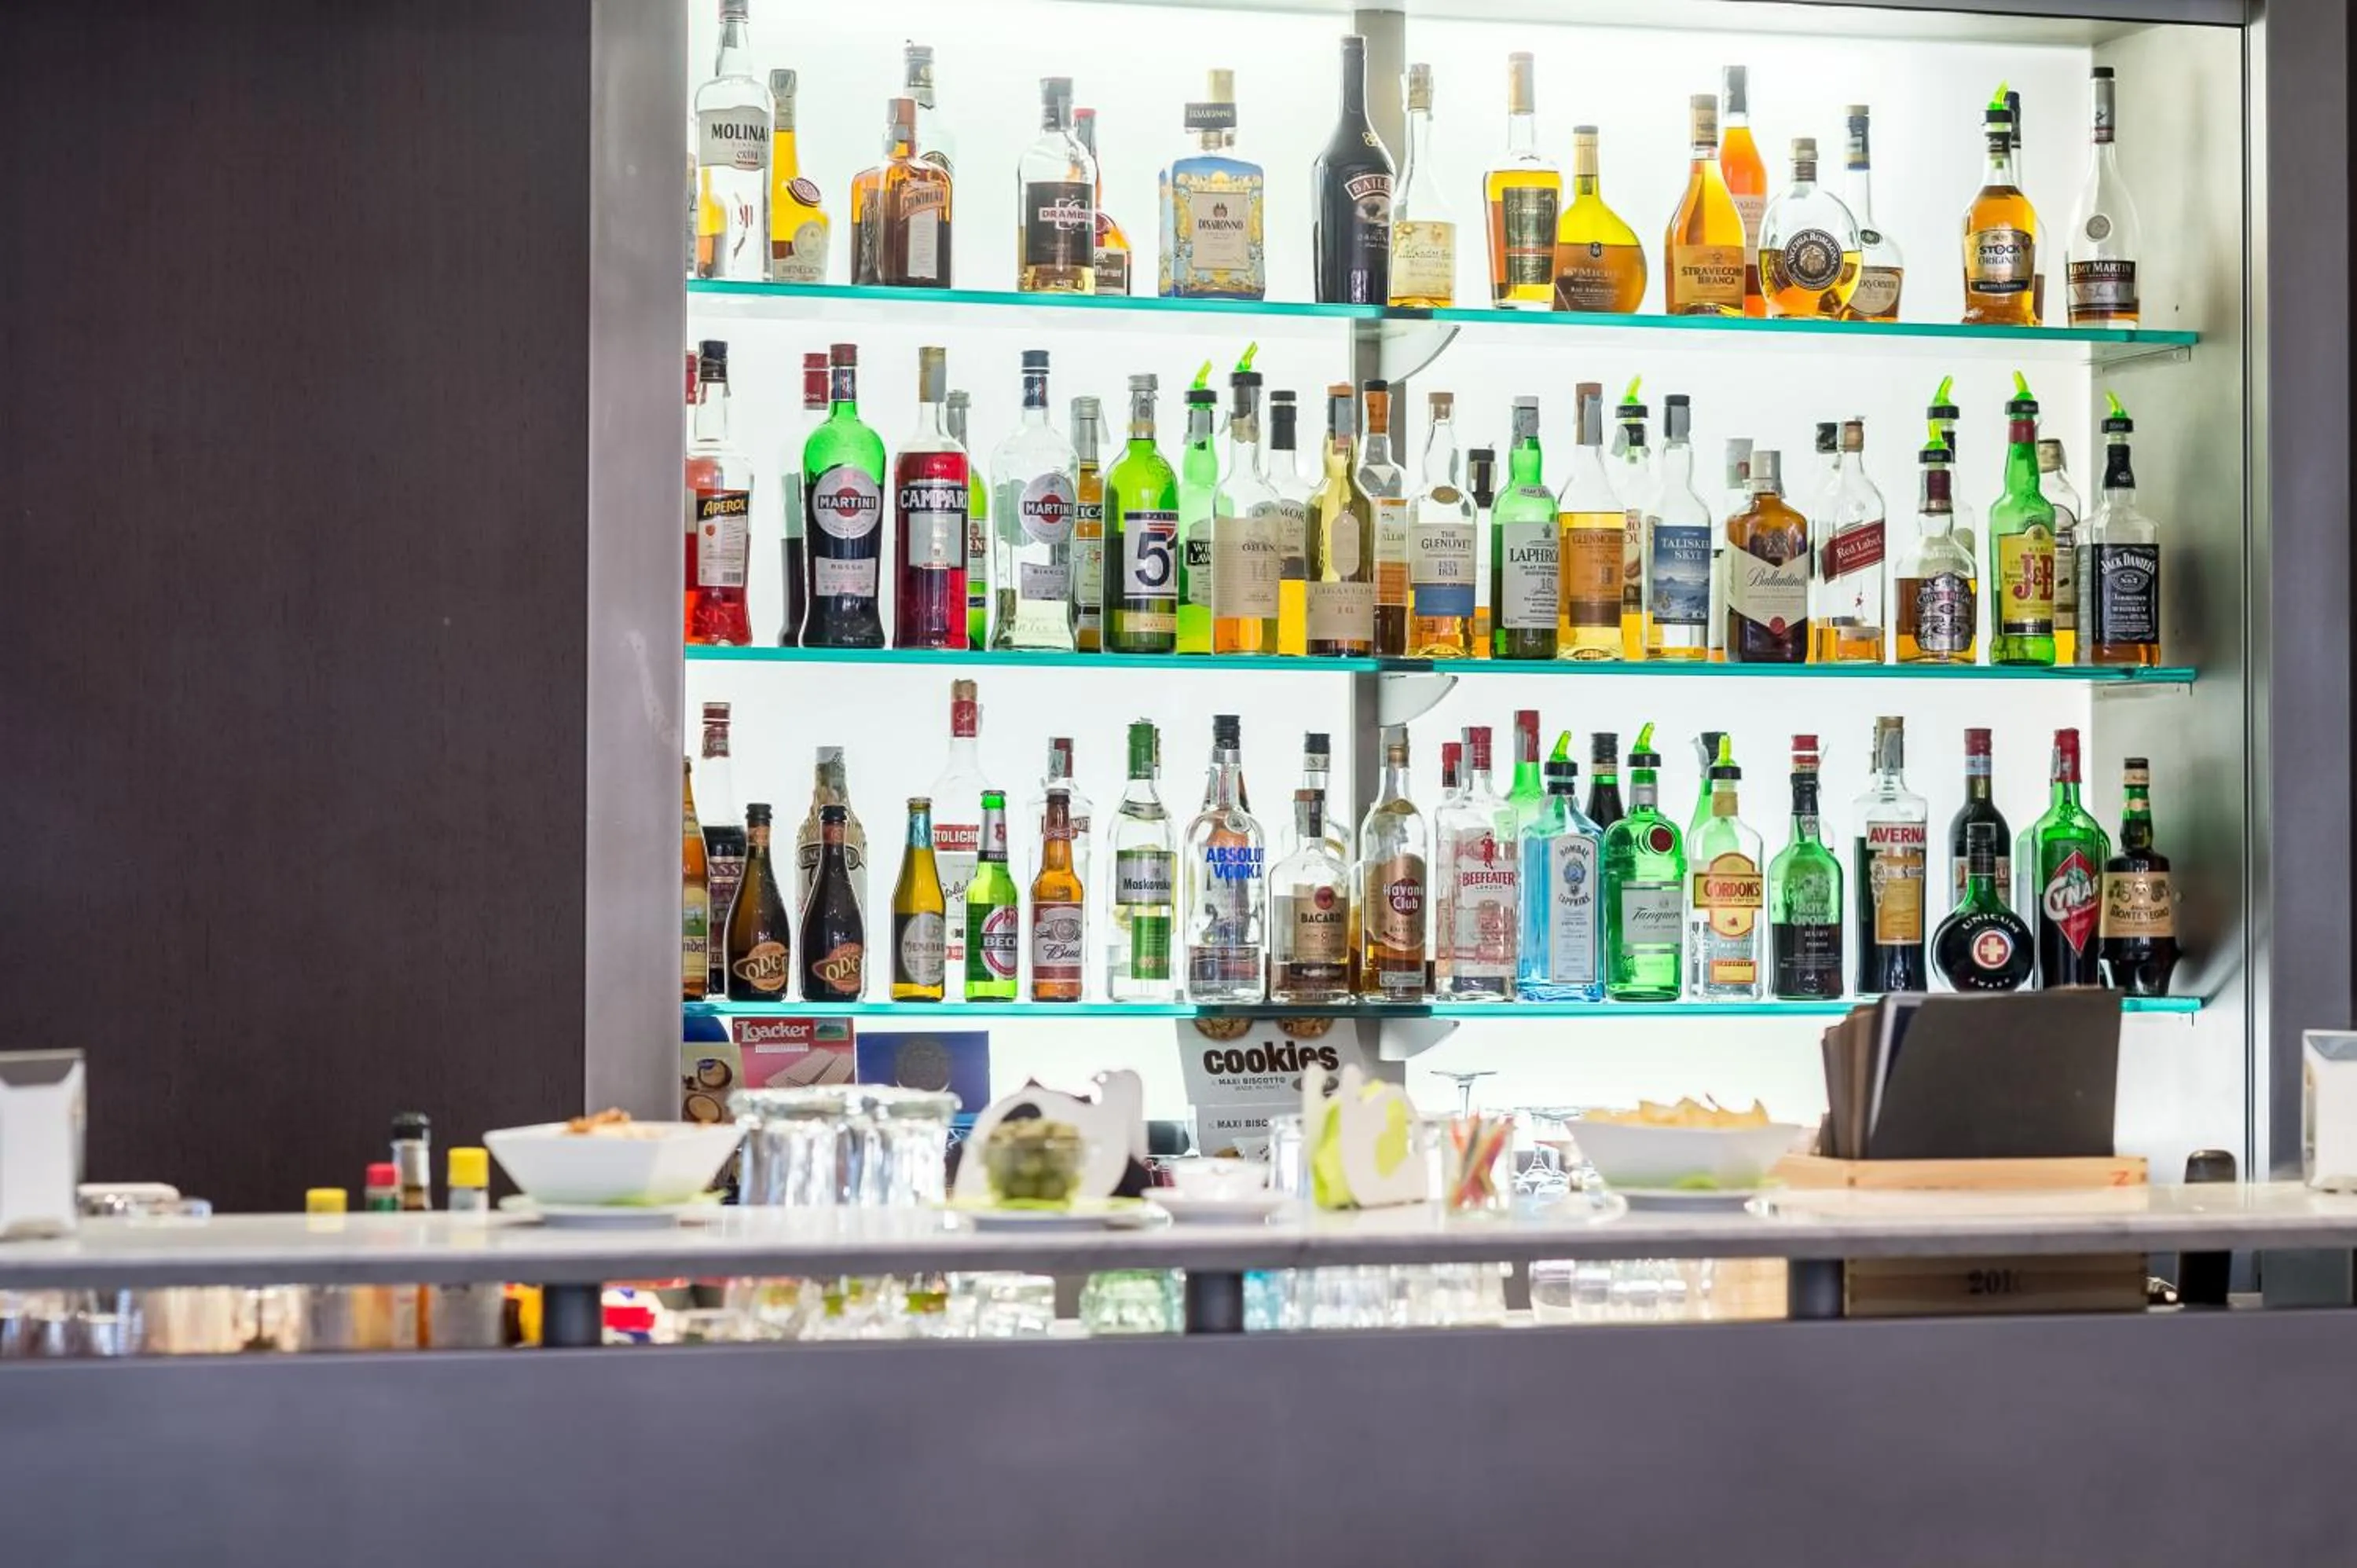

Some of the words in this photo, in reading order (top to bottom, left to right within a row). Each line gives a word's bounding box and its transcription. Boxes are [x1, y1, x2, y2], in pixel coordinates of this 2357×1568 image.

[711, 123, 769, 140] MOLINA
[1979, 244, 2022, 255] STOCK
[702, 498, 746, 516] APEROL
[819, 496, 876, 508] MARTINI
[1025, 501, 1073, 515] MARTINI
[1420, 538, 1472, 550] GLENLIVET
[1836, 545, 1856, 560] Red
[1856, 533, 1883, 551] Label
[2100, 557, 2124, 575] JACK
[1205, 847, 1265, 863] ABSOLUT
[1213, 863, 1263, 880] VODKA
[1461, 870, 1517, 887] BEEFEATER
[1392, 896, 1419, 910] Club
[1962, 913, 2022, 934] UNICUM
[1043, 943, 1082, 961] Bud
[734, 1021, 810, 1043] Loacker
[1203, 1041, 1340, 1075] cookies
[1242, 1076, 1287, 1085] BISCOTTO
[1217, 1119, 1241, 1129] MAXI
[1245, 1119, 1269, 1127] BISC
[1967, 1269, 2016, 1295] 201
